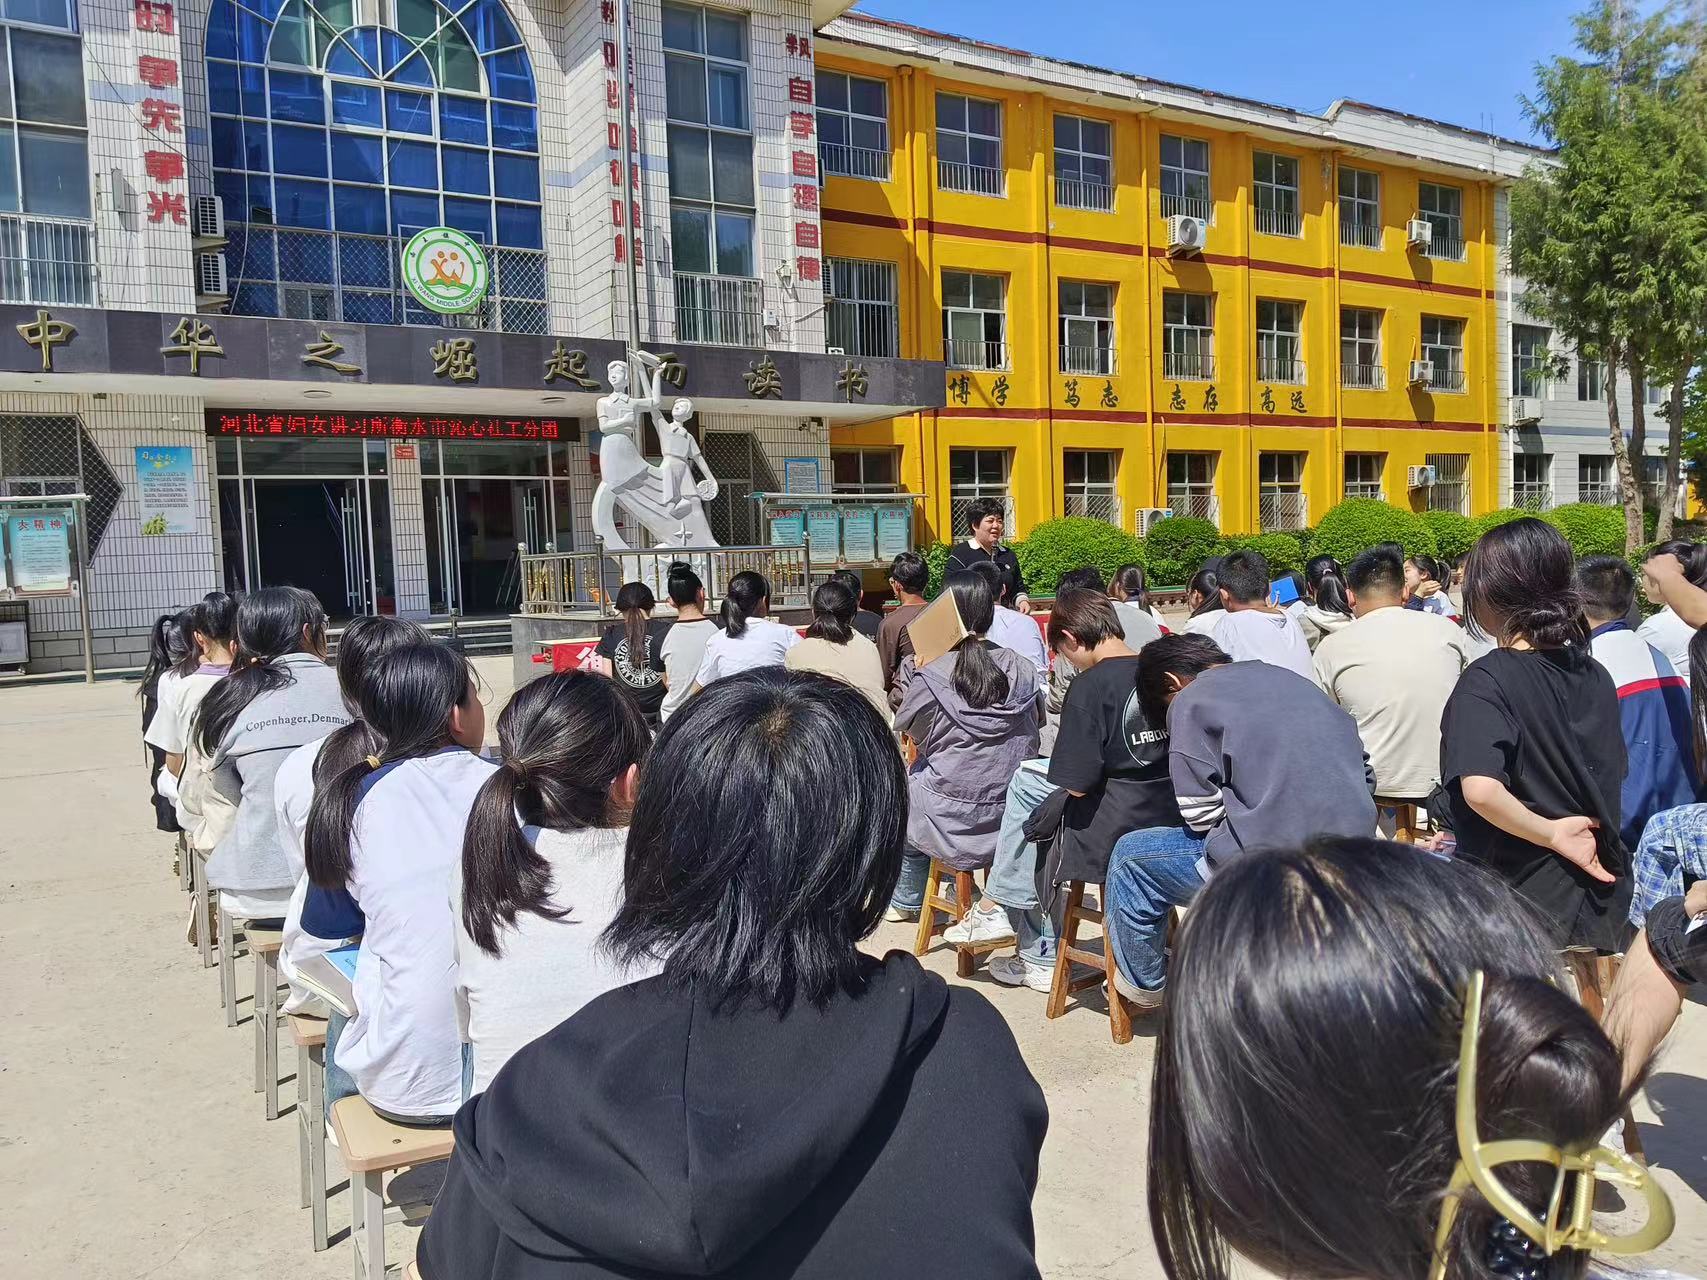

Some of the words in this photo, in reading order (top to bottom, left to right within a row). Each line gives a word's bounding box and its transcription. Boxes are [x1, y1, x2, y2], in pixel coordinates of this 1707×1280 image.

[418, 286, 434, 301] WANG
[436, 299, 460, 307] MIDDLE
[462, 287, 482, 305] SCHOOL
